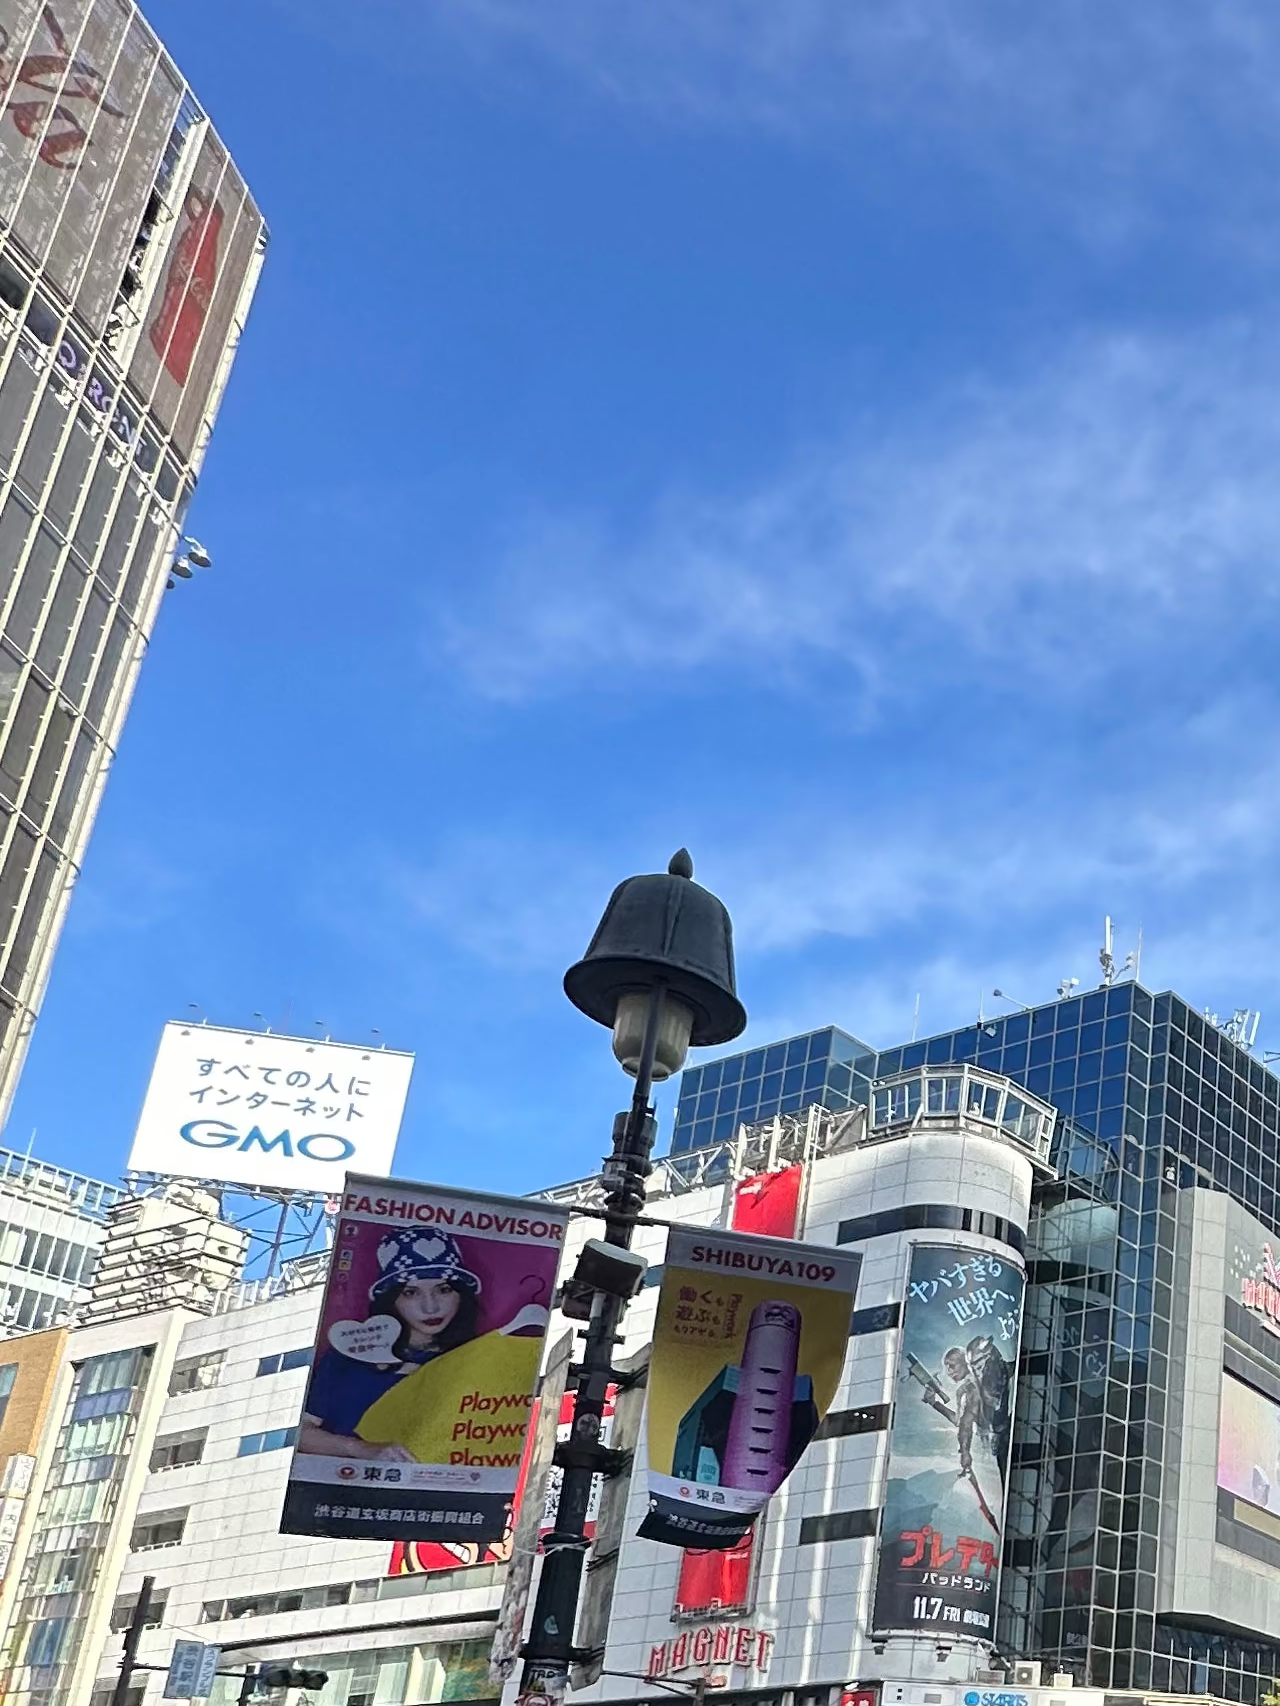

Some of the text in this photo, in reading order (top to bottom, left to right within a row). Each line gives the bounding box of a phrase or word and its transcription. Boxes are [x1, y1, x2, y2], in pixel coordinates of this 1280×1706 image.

[196, 1058, 371, 1096] すべての人に
[189, 1085, 364, 1121] インターネット
[179, 1119, 356, 1162] GMO
[344, 1193, 563, 1241] FASHION ADVISOR
[691, 1246, 836, 1282] SHIBUYA109
[909, 1254, 1002, 1303] ヤバすぎる
[363, 1466, 403, 1482] 東急
[696, 1488, 726, 1505] 東急
[913, 1596, 943, 1620] 11.7
[943, 1605, 961, 1622] FRI
[647, 1624, 775, 1677] MAGNET
